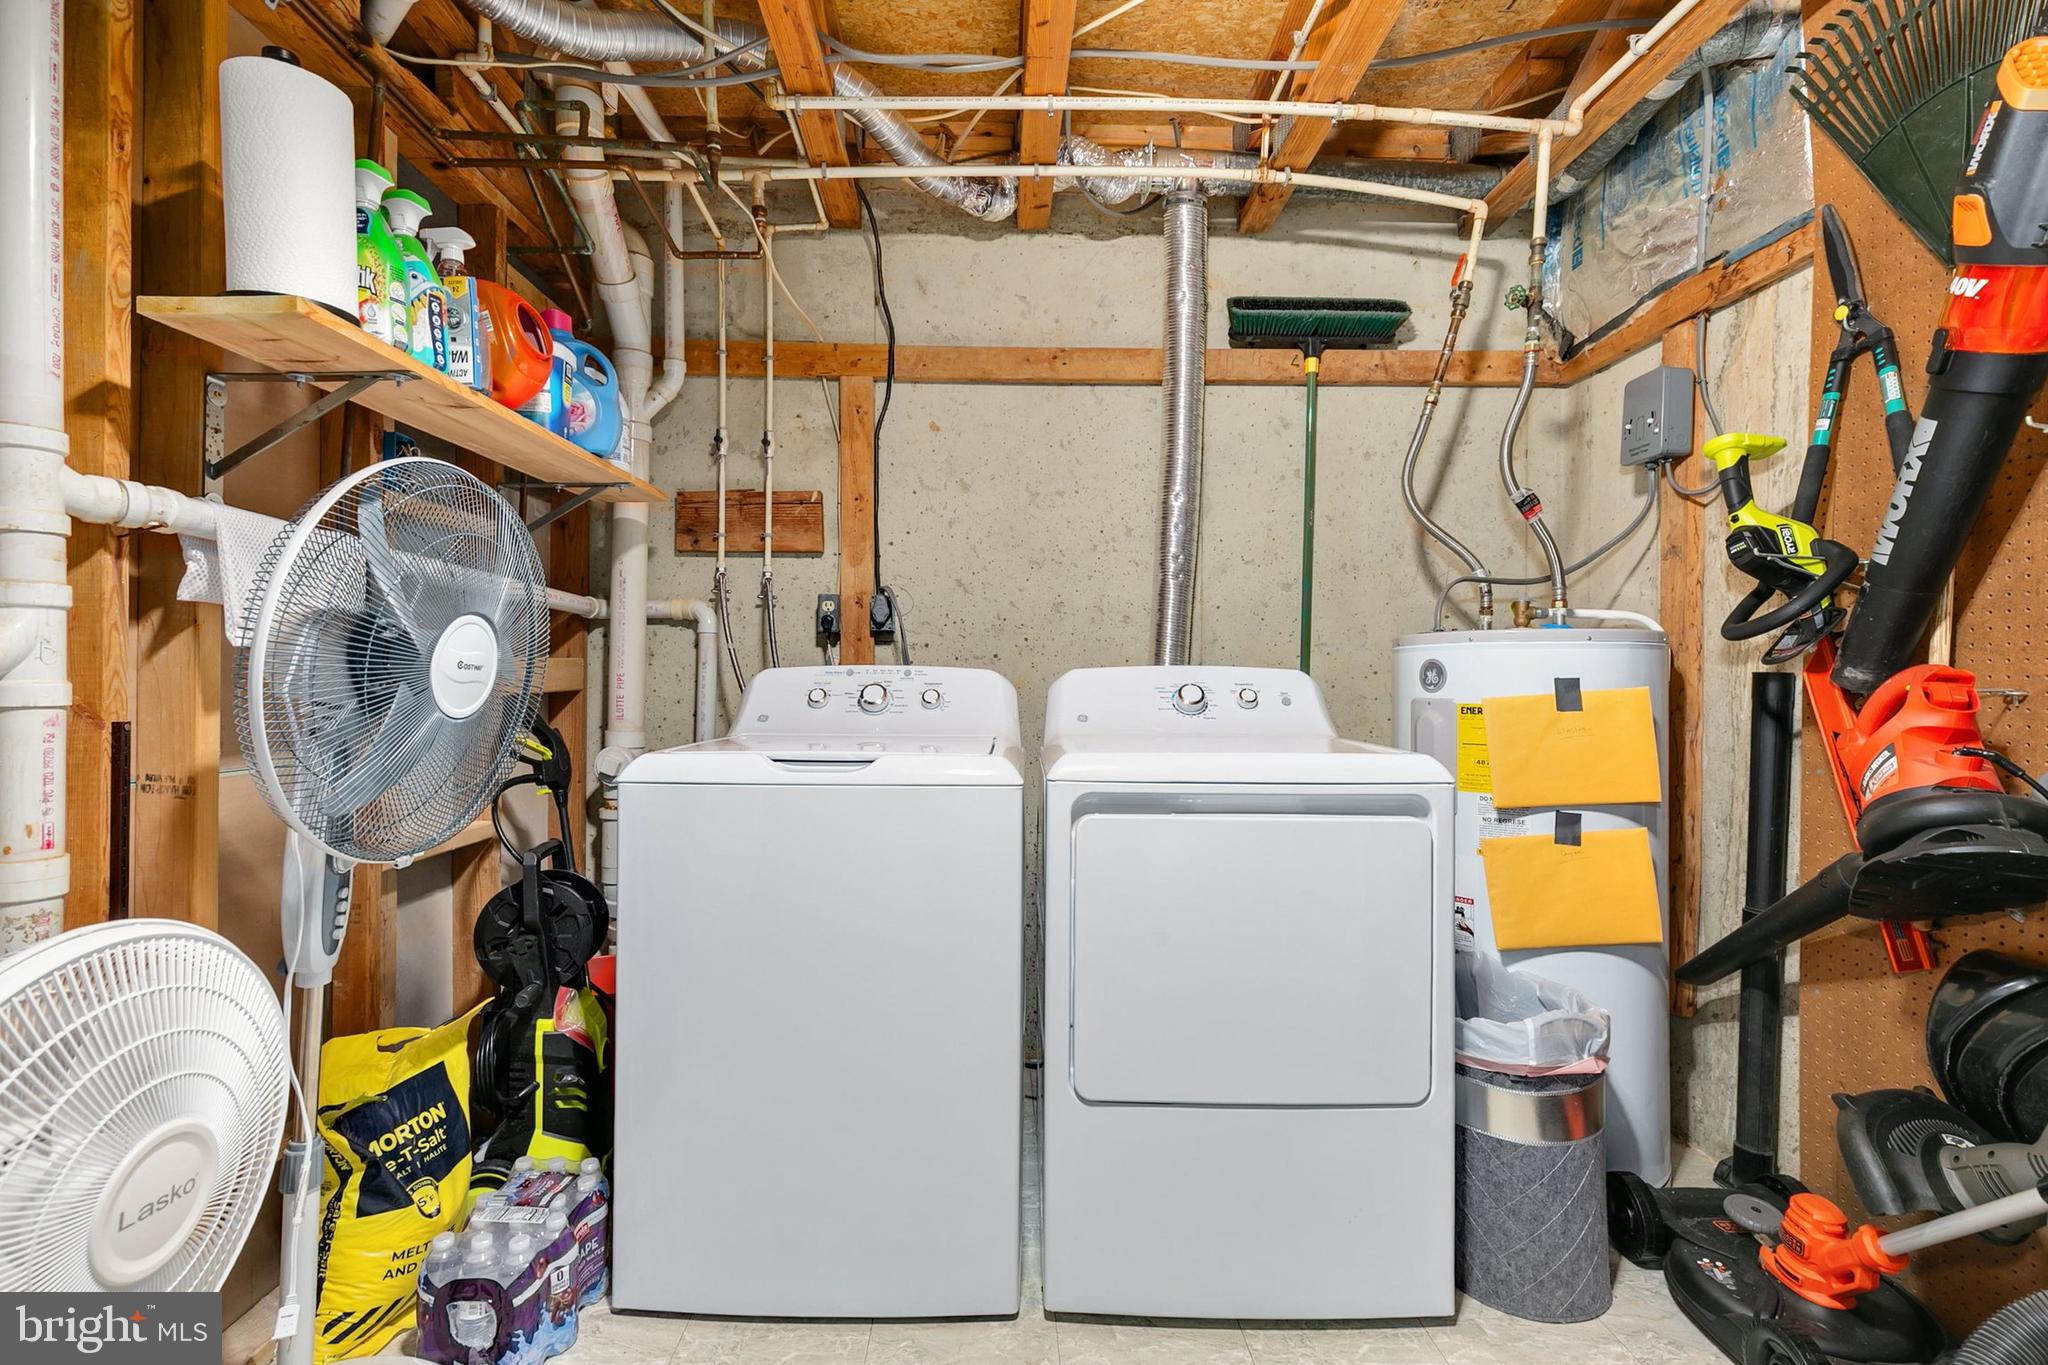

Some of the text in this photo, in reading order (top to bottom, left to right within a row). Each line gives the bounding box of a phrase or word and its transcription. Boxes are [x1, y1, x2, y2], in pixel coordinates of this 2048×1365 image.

[1870, 432, 1933, 563] WORX
[1780, 528, 1797, 555] RYOBI
[615, 672, 625, 690] PIPE
[423, 1143, 449, 1163] HALITE
[118, 1177, 197, 1232] Lasko
[383, 1262, 418, 1281] AND
[556, 1270, 565, 1282] 0
